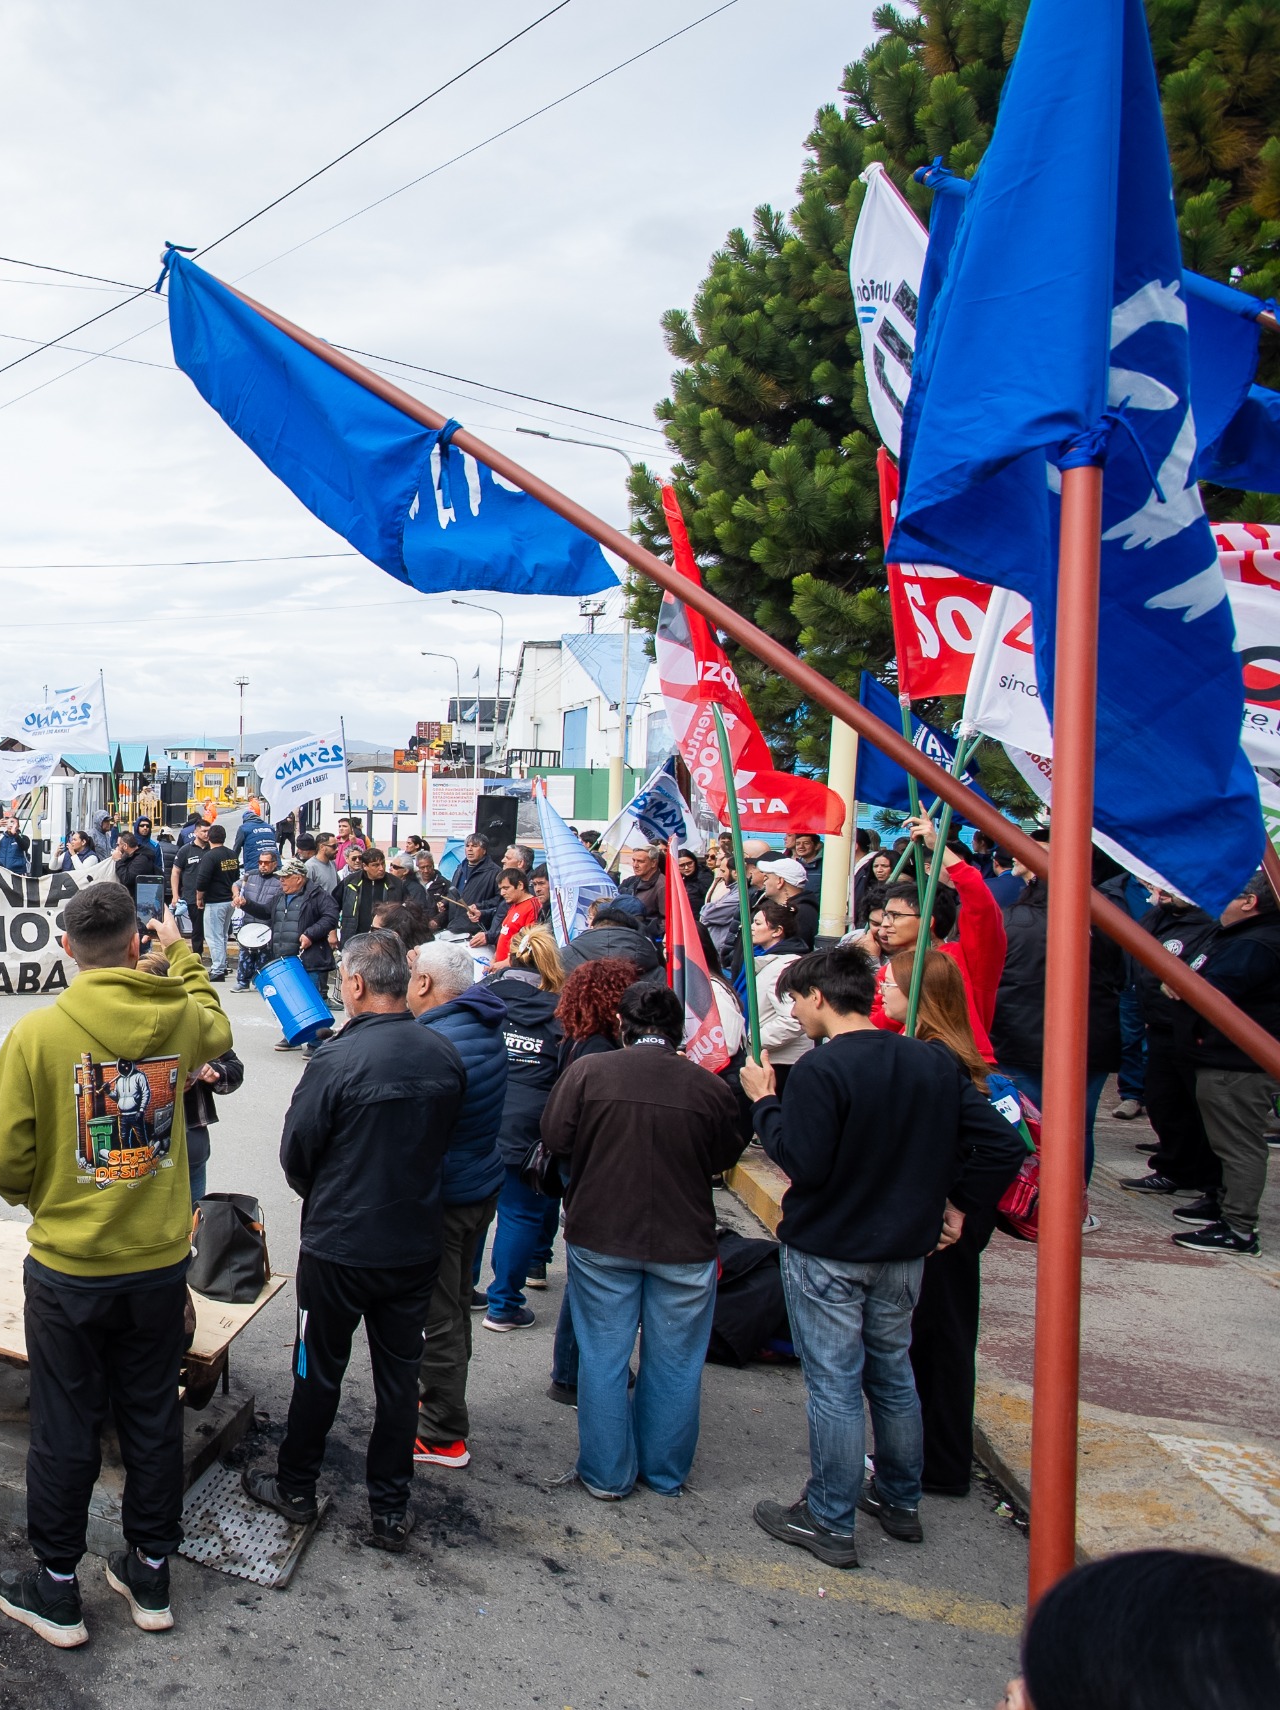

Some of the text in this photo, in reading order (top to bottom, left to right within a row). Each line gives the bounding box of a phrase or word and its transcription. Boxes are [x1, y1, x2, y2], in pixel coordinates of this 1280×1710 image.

[645, 800, 687, 838] MAYO
[506, 1032, 536, 1043] PROVINCIAL
[635, 1037, 666, 1046] SONY
[108, 1145, 156, 1166] SEEK
